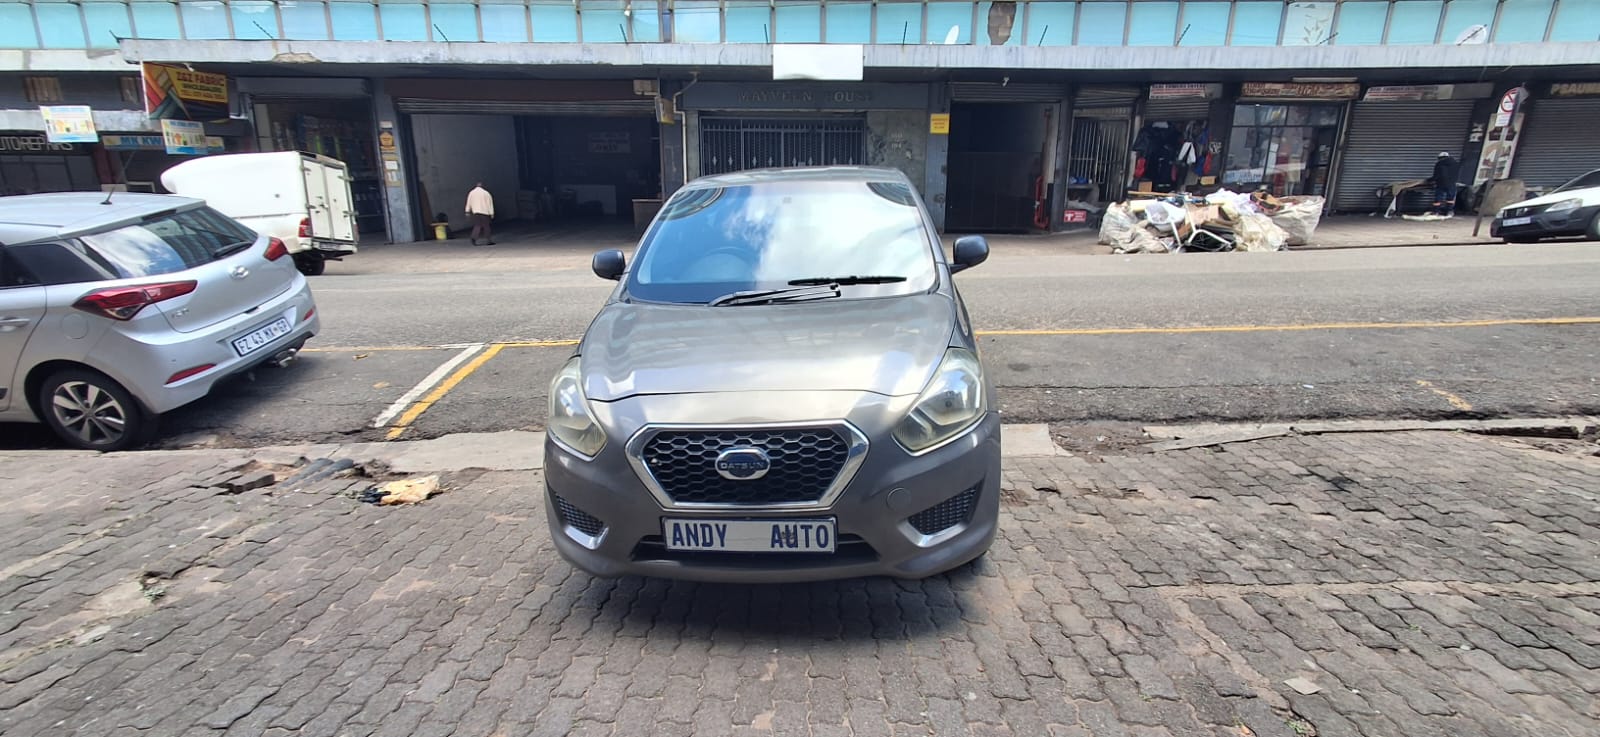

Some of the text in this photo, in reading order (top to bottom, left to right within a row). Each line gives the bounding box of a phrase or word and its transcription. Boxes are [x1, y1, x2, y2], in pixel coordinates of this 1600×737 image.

[194, 73, 225, 87] FABRIC
[237, 338, 252, 353] FZ
[251, 332, 265, 345] 43
[719, 461, 765, 470] DATSUN
[672, 522, 829, 549] ANDY AUTO
